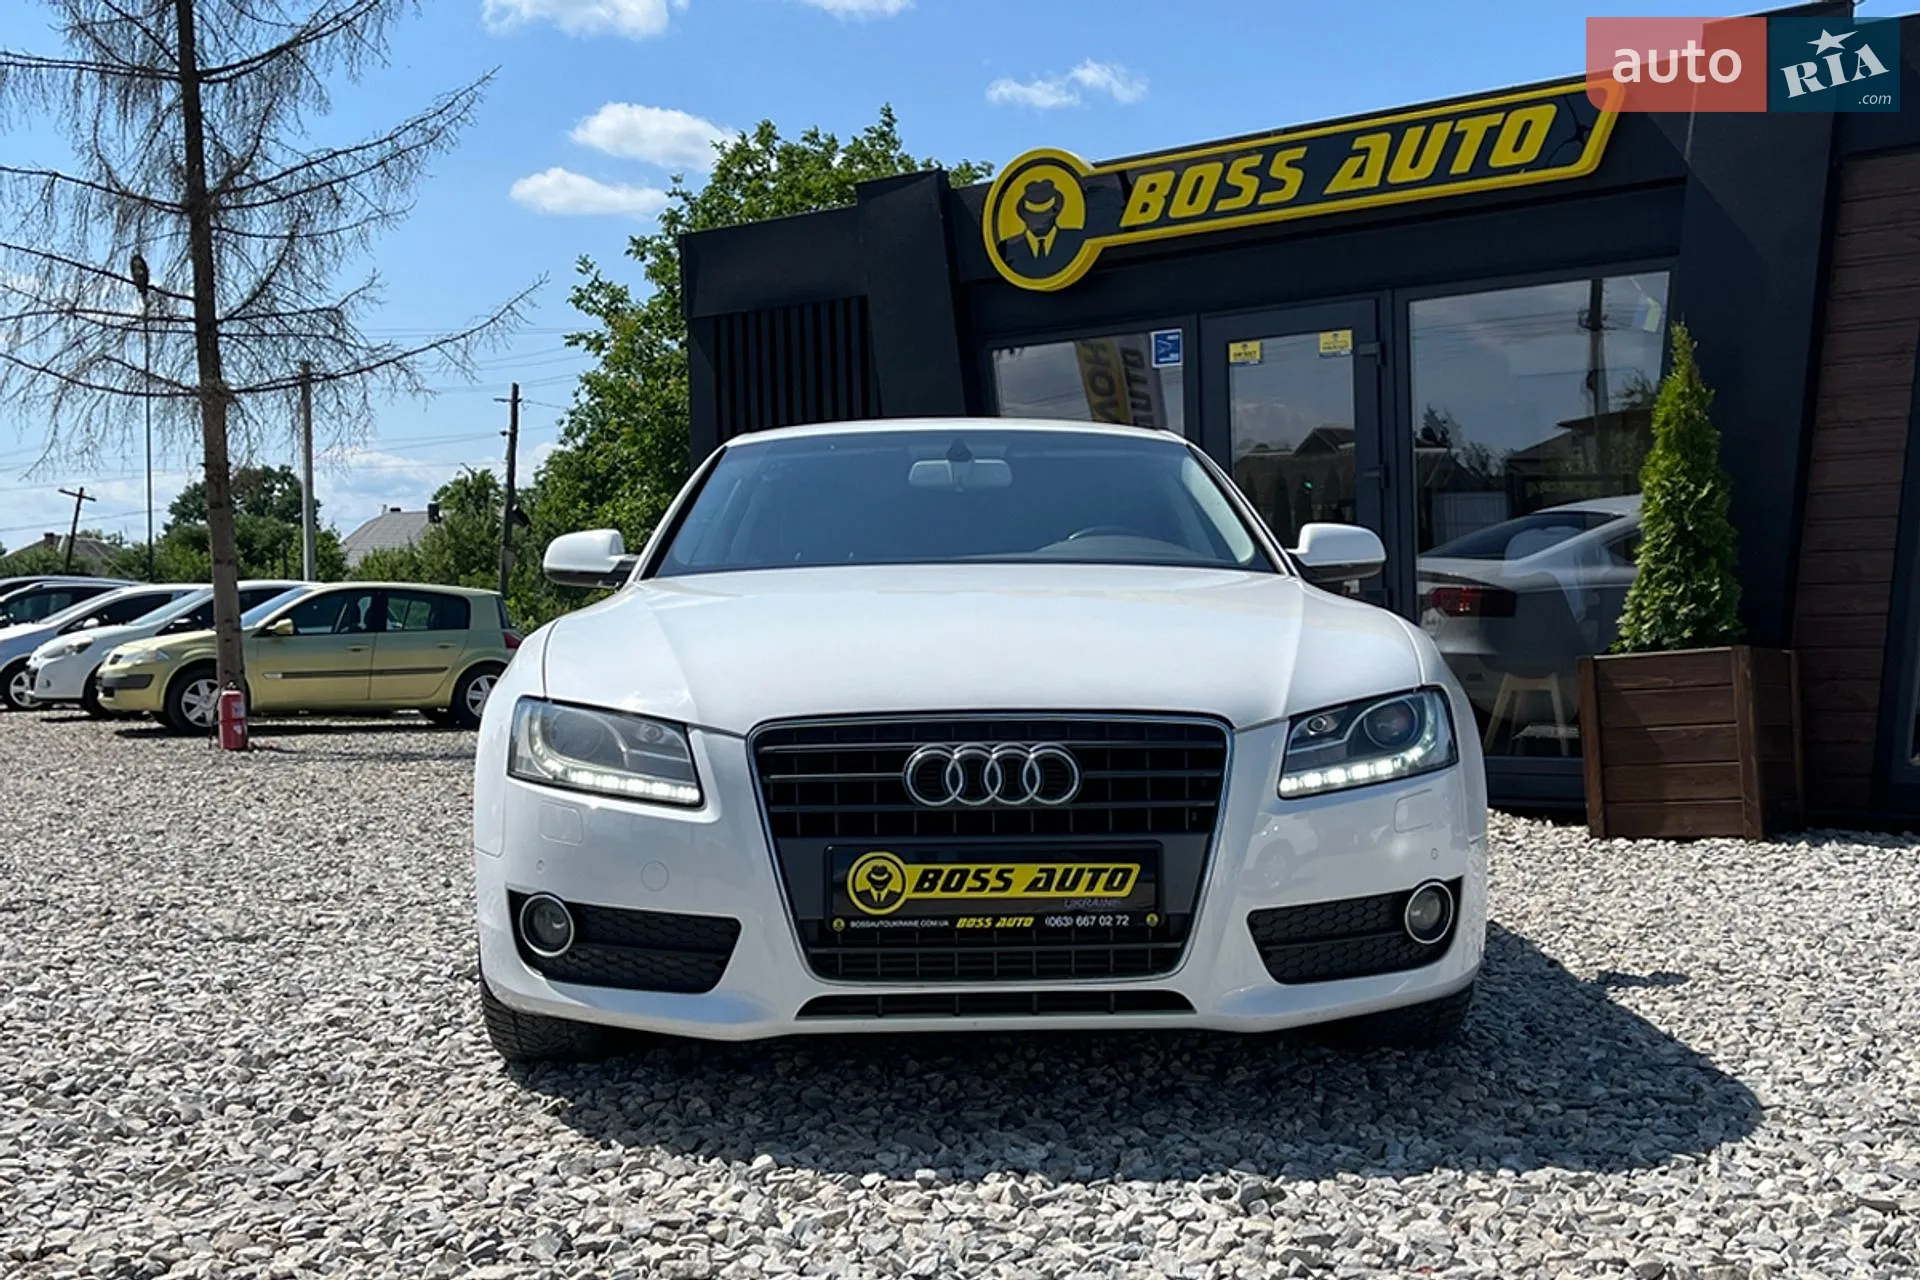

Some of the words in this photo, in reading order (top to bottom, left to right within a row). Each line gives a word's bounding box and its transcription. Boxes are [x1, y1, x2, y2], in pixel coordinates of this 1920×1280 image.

[1120, 146, 1308, 228] BOSS
[1324, 104, 1558, 195] AUTO
[912, 867, 1015, 893] BOSS
[1023, 867, 1134, 893] AUTO
[956, 916, 993, 928] BOSS
[995, 916, 1035, 928] AUTO
[1045, 916, 1073, 927] (063)
[1075, 915, 1096, 927] 667
[1099, 915, 1113, 926] 02
[1115, 915, 1130, 926] 72
